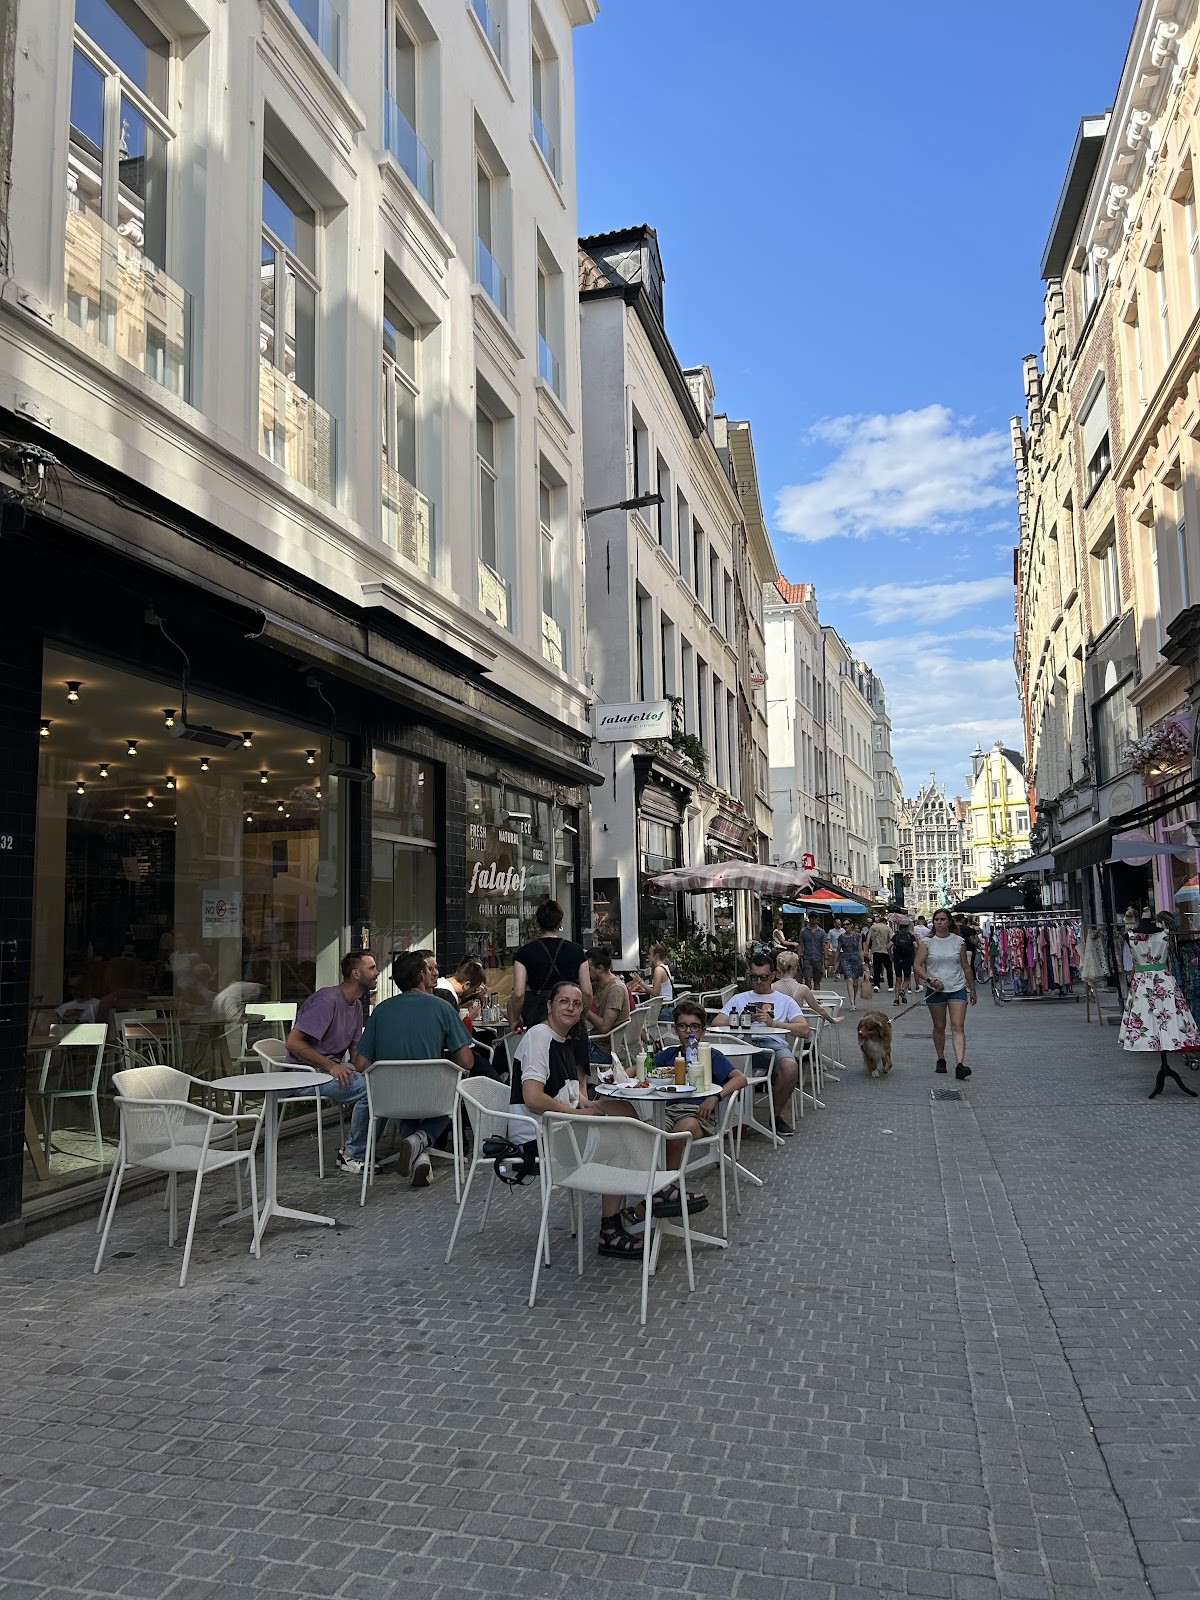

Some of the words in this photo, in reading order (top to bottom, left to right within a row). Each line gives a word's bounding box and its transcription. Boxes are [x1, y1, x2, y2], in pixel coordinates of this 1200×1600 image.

[601, 711, 665, 726] falafeltof
[470, 823, 487, 839] FRESH
[498, 829, 519, 845] NATURAL
[1, 835, 13, 850] 32
[470, 836, 487, 852] DAILY
[205, 906, 215, 915] NO
